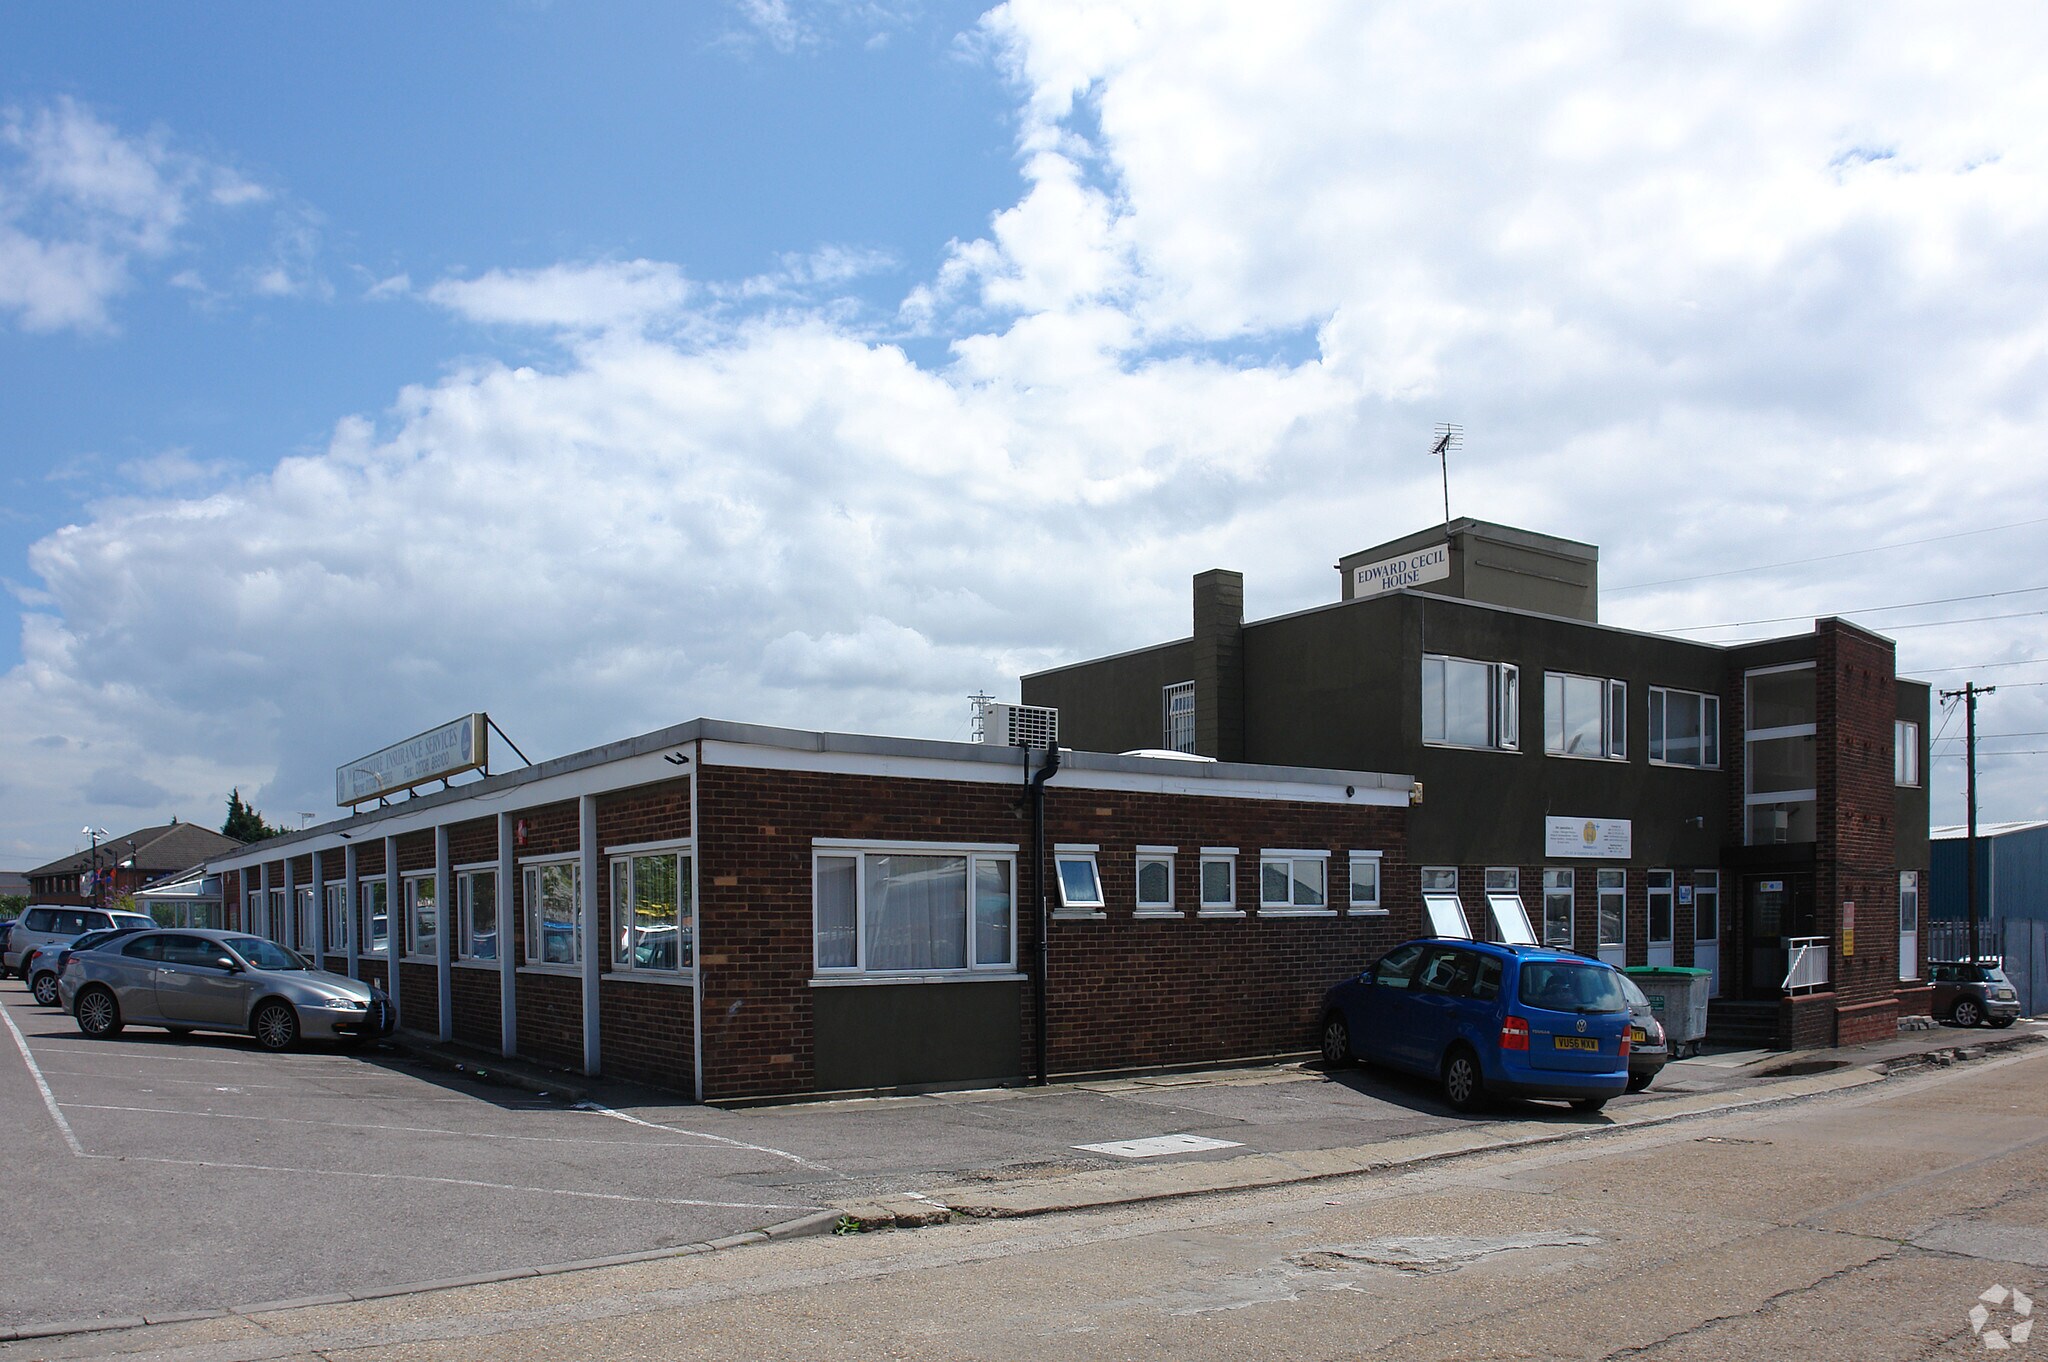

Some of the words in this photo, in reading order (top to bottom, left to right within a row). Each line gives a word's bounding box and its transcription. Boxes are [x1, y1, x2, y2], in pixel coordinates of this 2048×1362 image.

[1358, 560, 1407, 584] EDWARD
[1411, 549, 1446, 570] CECIL
[1382, 569, 1420, 590] HOUSE
[386, 741, 423, 769] INSURANCE
[425, 726, 458, 755] SERVICES
